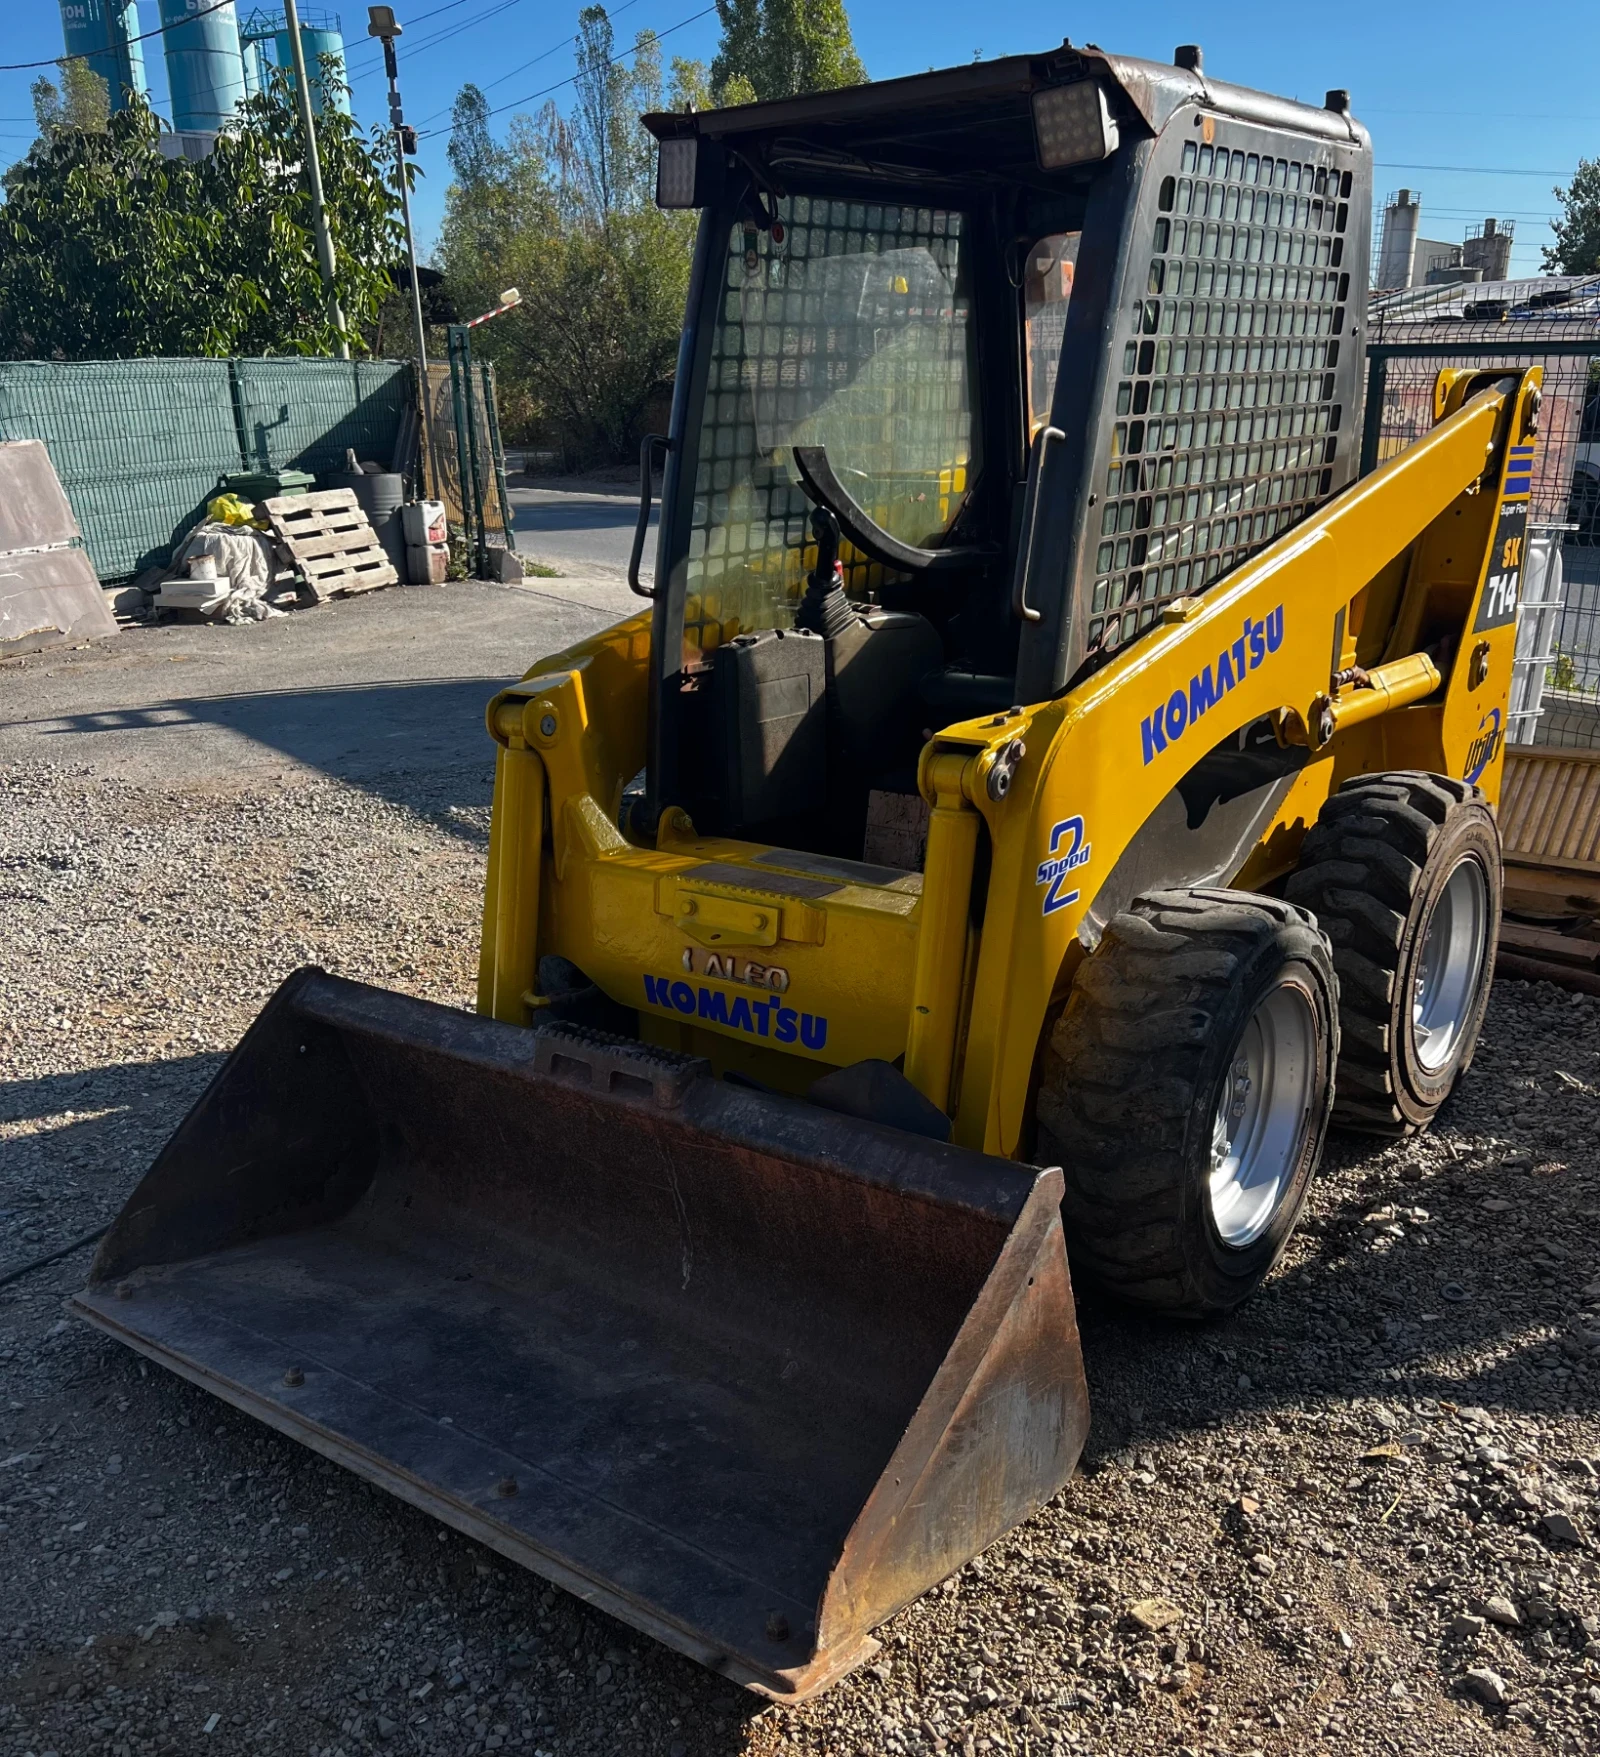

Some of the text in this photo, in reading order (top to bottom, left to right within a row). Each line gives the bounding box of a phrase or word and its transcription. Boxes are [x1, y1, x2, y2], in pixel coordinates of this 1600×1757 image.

[1500, 502, 1528, 518] Super Flow
[1501, 537, 1522, 569] SK
[1486, 571, 1518, 619] 714
[1139, 603, 1286, 767] KOMATSU
[1463, 727, 1506, 777] Utility
[1035, 814, 1092, 917] 2 Speed
[643, 973, 828, 1050] KOMATSU
